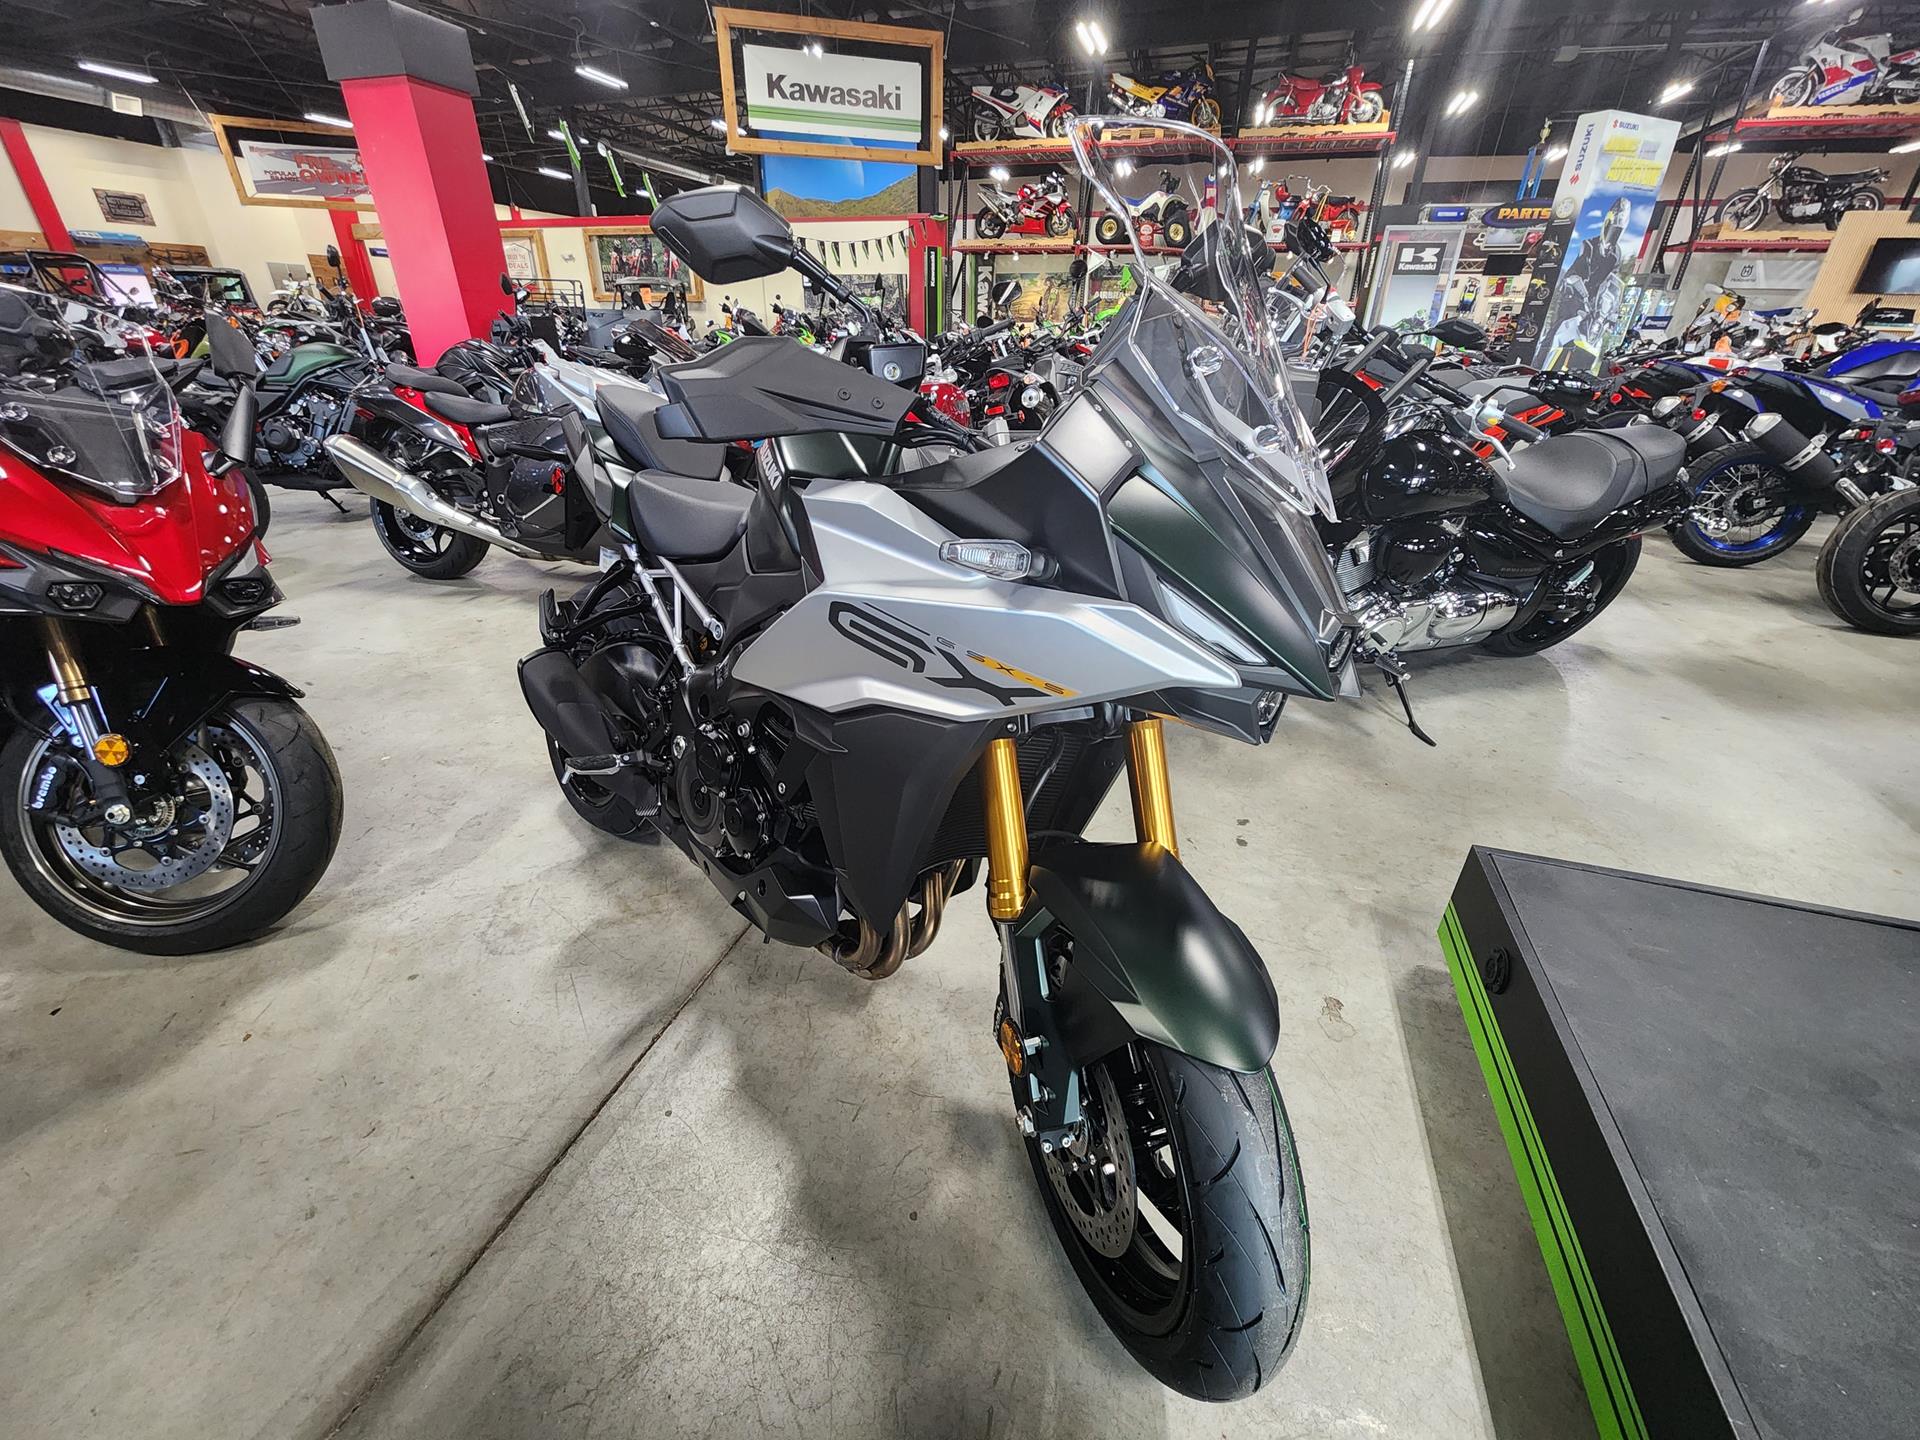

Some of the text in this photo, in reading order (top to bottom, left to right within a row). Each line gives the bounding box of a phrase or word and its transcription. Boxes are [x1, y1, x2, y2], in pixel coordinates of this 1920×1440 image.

[766, 72, 902, 111] Kawasaki
[1619, 120, 1640, 131] SUZUKI
[1575, 122, 1596, 172] SUZUKI
[264, 169, 297, 177] POPULAR
[299, 168, 368, 185] OWNE
[1497, 207, 1553, 220] PARTS
[1398, 262, 1437, 271] Kawasaki
[31, 766, 58, 809] brembo
